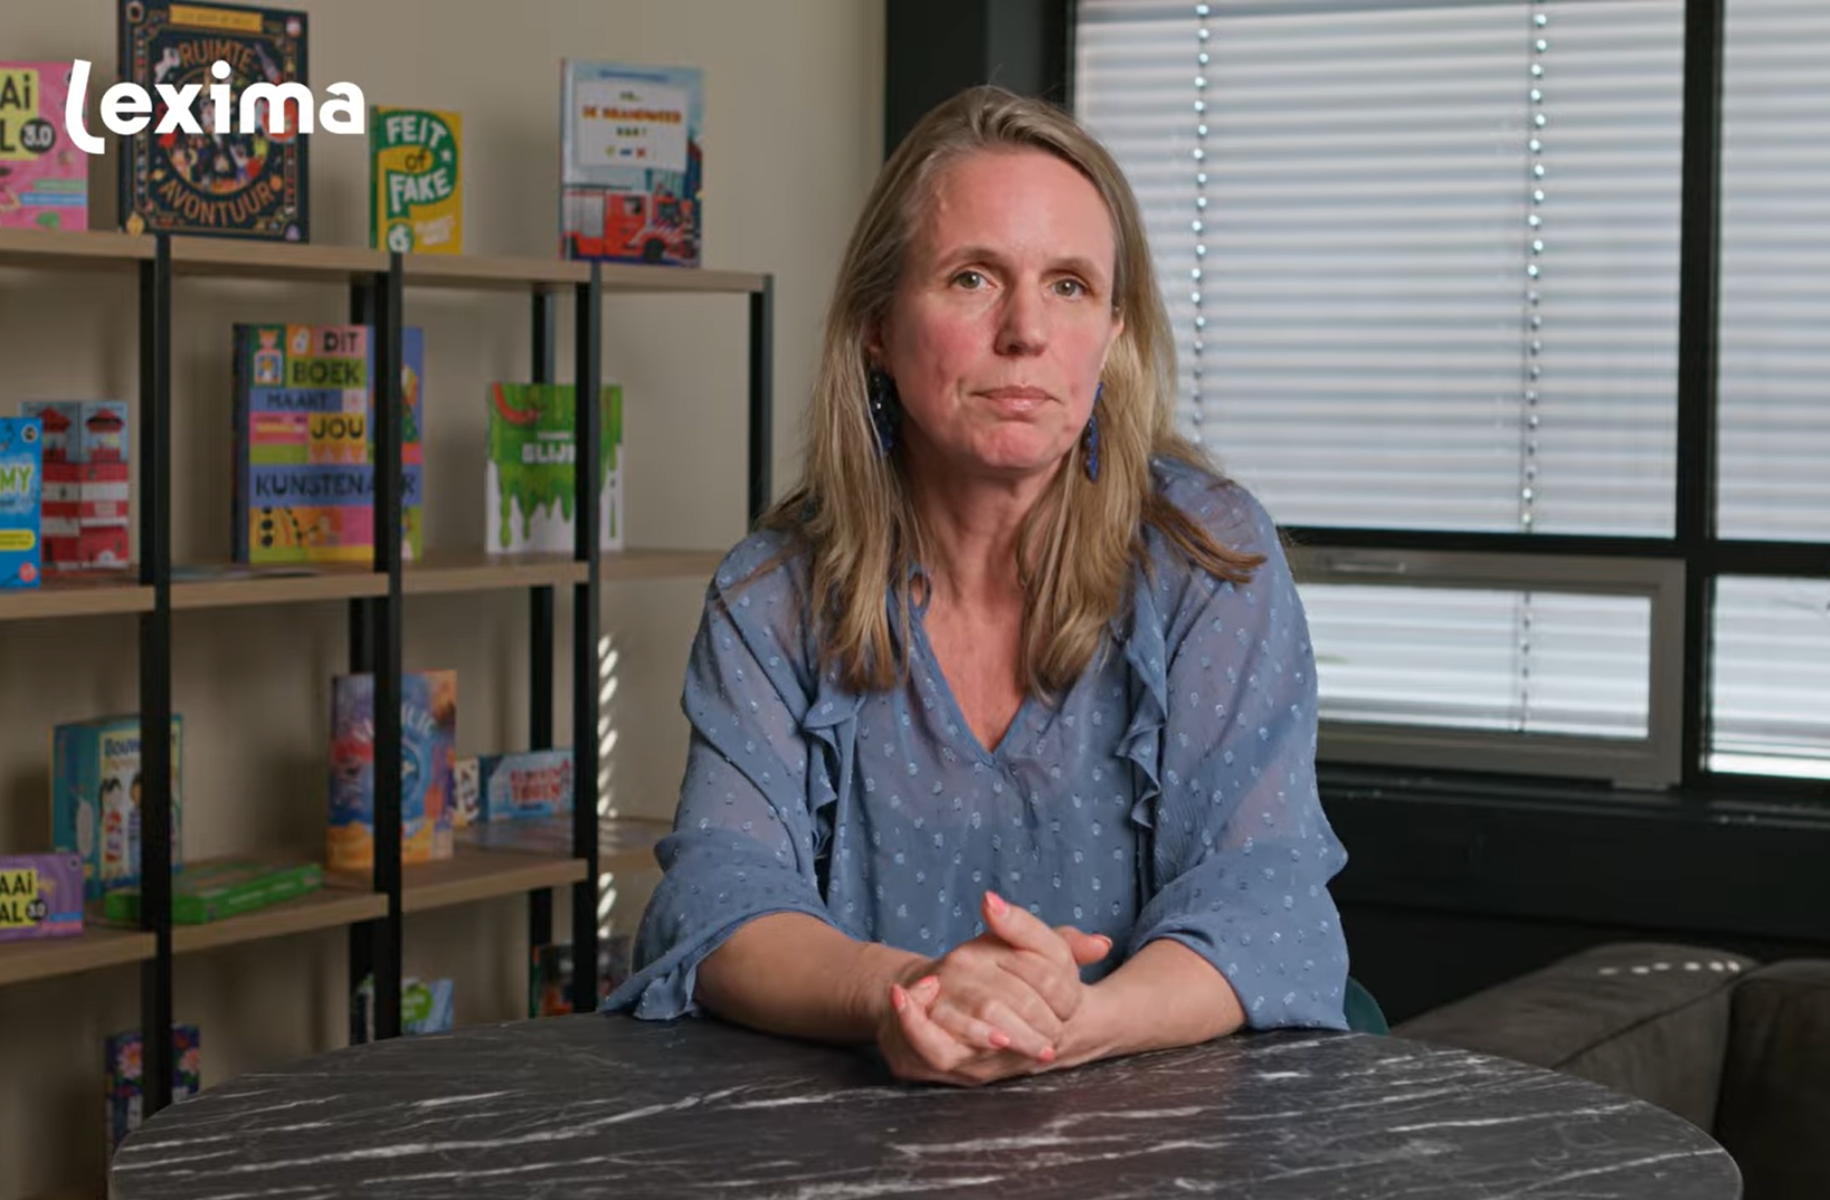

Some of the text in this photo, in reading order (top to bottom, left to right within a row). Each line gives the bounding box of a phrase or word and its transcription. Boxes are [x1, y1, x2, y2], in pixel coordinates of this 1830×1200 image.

[178, 39, 253, 71] RUIMTE
[23, 125, 53, 147] 3.0
[386, 115, 448, 149] FEIT
[158, 178, 274, 226] AVONTUUR
[390, 167, 452, 213] FAKE
[323, 332, 359, 353] DIT
[293, 361, 361, 385] BOEK
[311, 419, 364, 440] JOU
